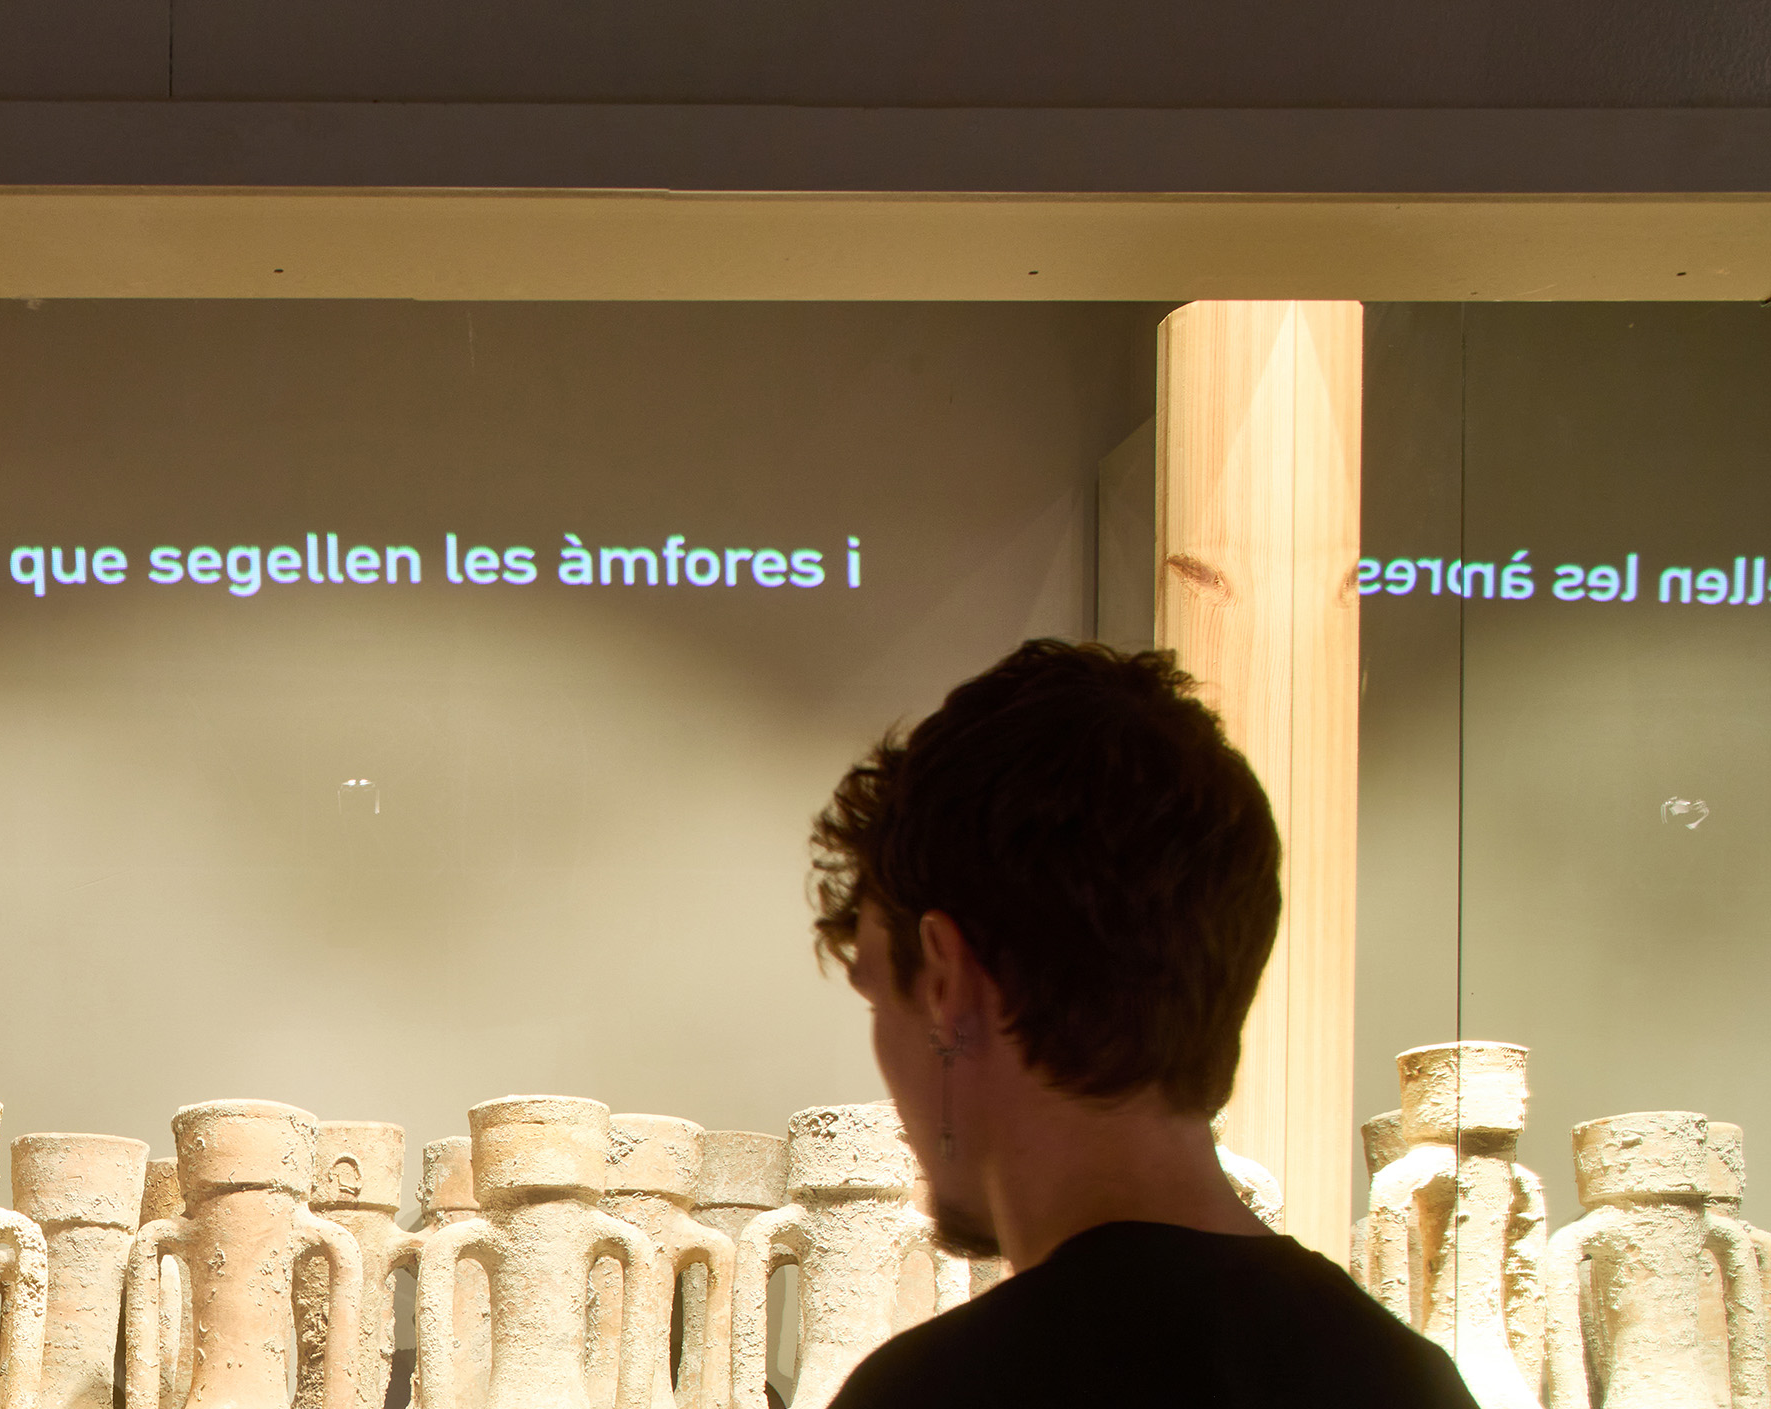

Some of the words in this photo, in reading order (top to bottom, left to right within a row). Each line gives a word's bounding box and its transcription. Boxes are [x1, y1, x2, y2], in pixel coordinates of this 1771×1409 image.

[9, 546, 128, 598] que
[148, 532, 422, 598] segellen
[445, 532, 538, 585] les
[557, 532, 826, 588] àmfores
[846, 536, 861, 589] i
